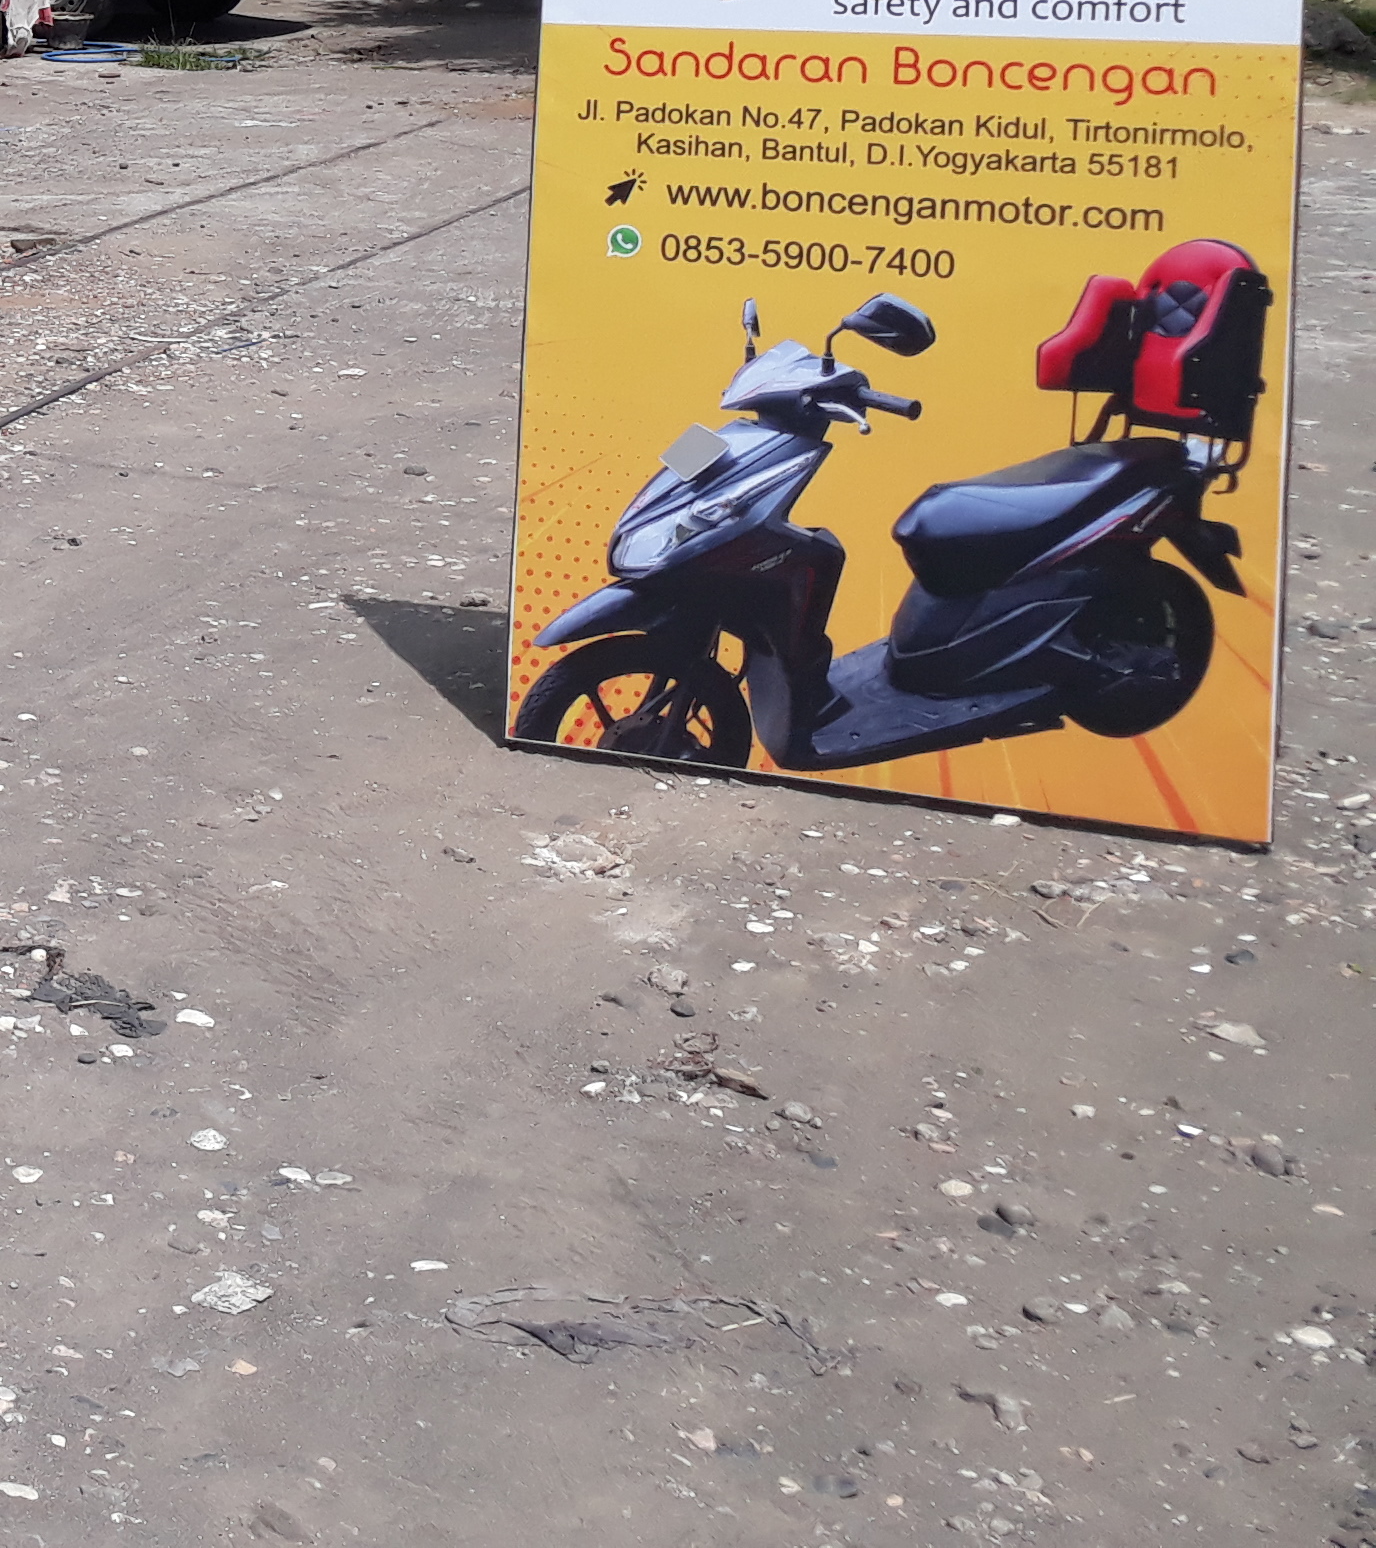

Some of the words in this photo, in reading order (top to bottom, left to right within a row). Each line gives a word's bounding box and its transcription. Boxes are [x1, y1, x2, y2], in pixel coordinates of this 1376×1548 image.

[604, 37, 867, 84] Sandaran
[893, 46, 1217, 106] Boncengan
[578, 99, 605, 122] Jl.
[616, 101, 731, 128] Padokan
[741, 106, 829, 134] No.47,
[841, 110, 964, 137] Padokan
[975, 115, 1054, 143] Kidul,
[1066, 118, 1253, 152] Tirtonirmolo,
[637, 133, 750, 162] Kasihan,
[762, 138, 854, 167] Bantul,
[867, 143, 1076, 175] D.I.Yogyakarta
[1087, 154, 1178, 178] 55181
[666, 183, 1164, 231] www.boncenganmotor.com
[661, 234, 955, 279] 0853-5900-7400
